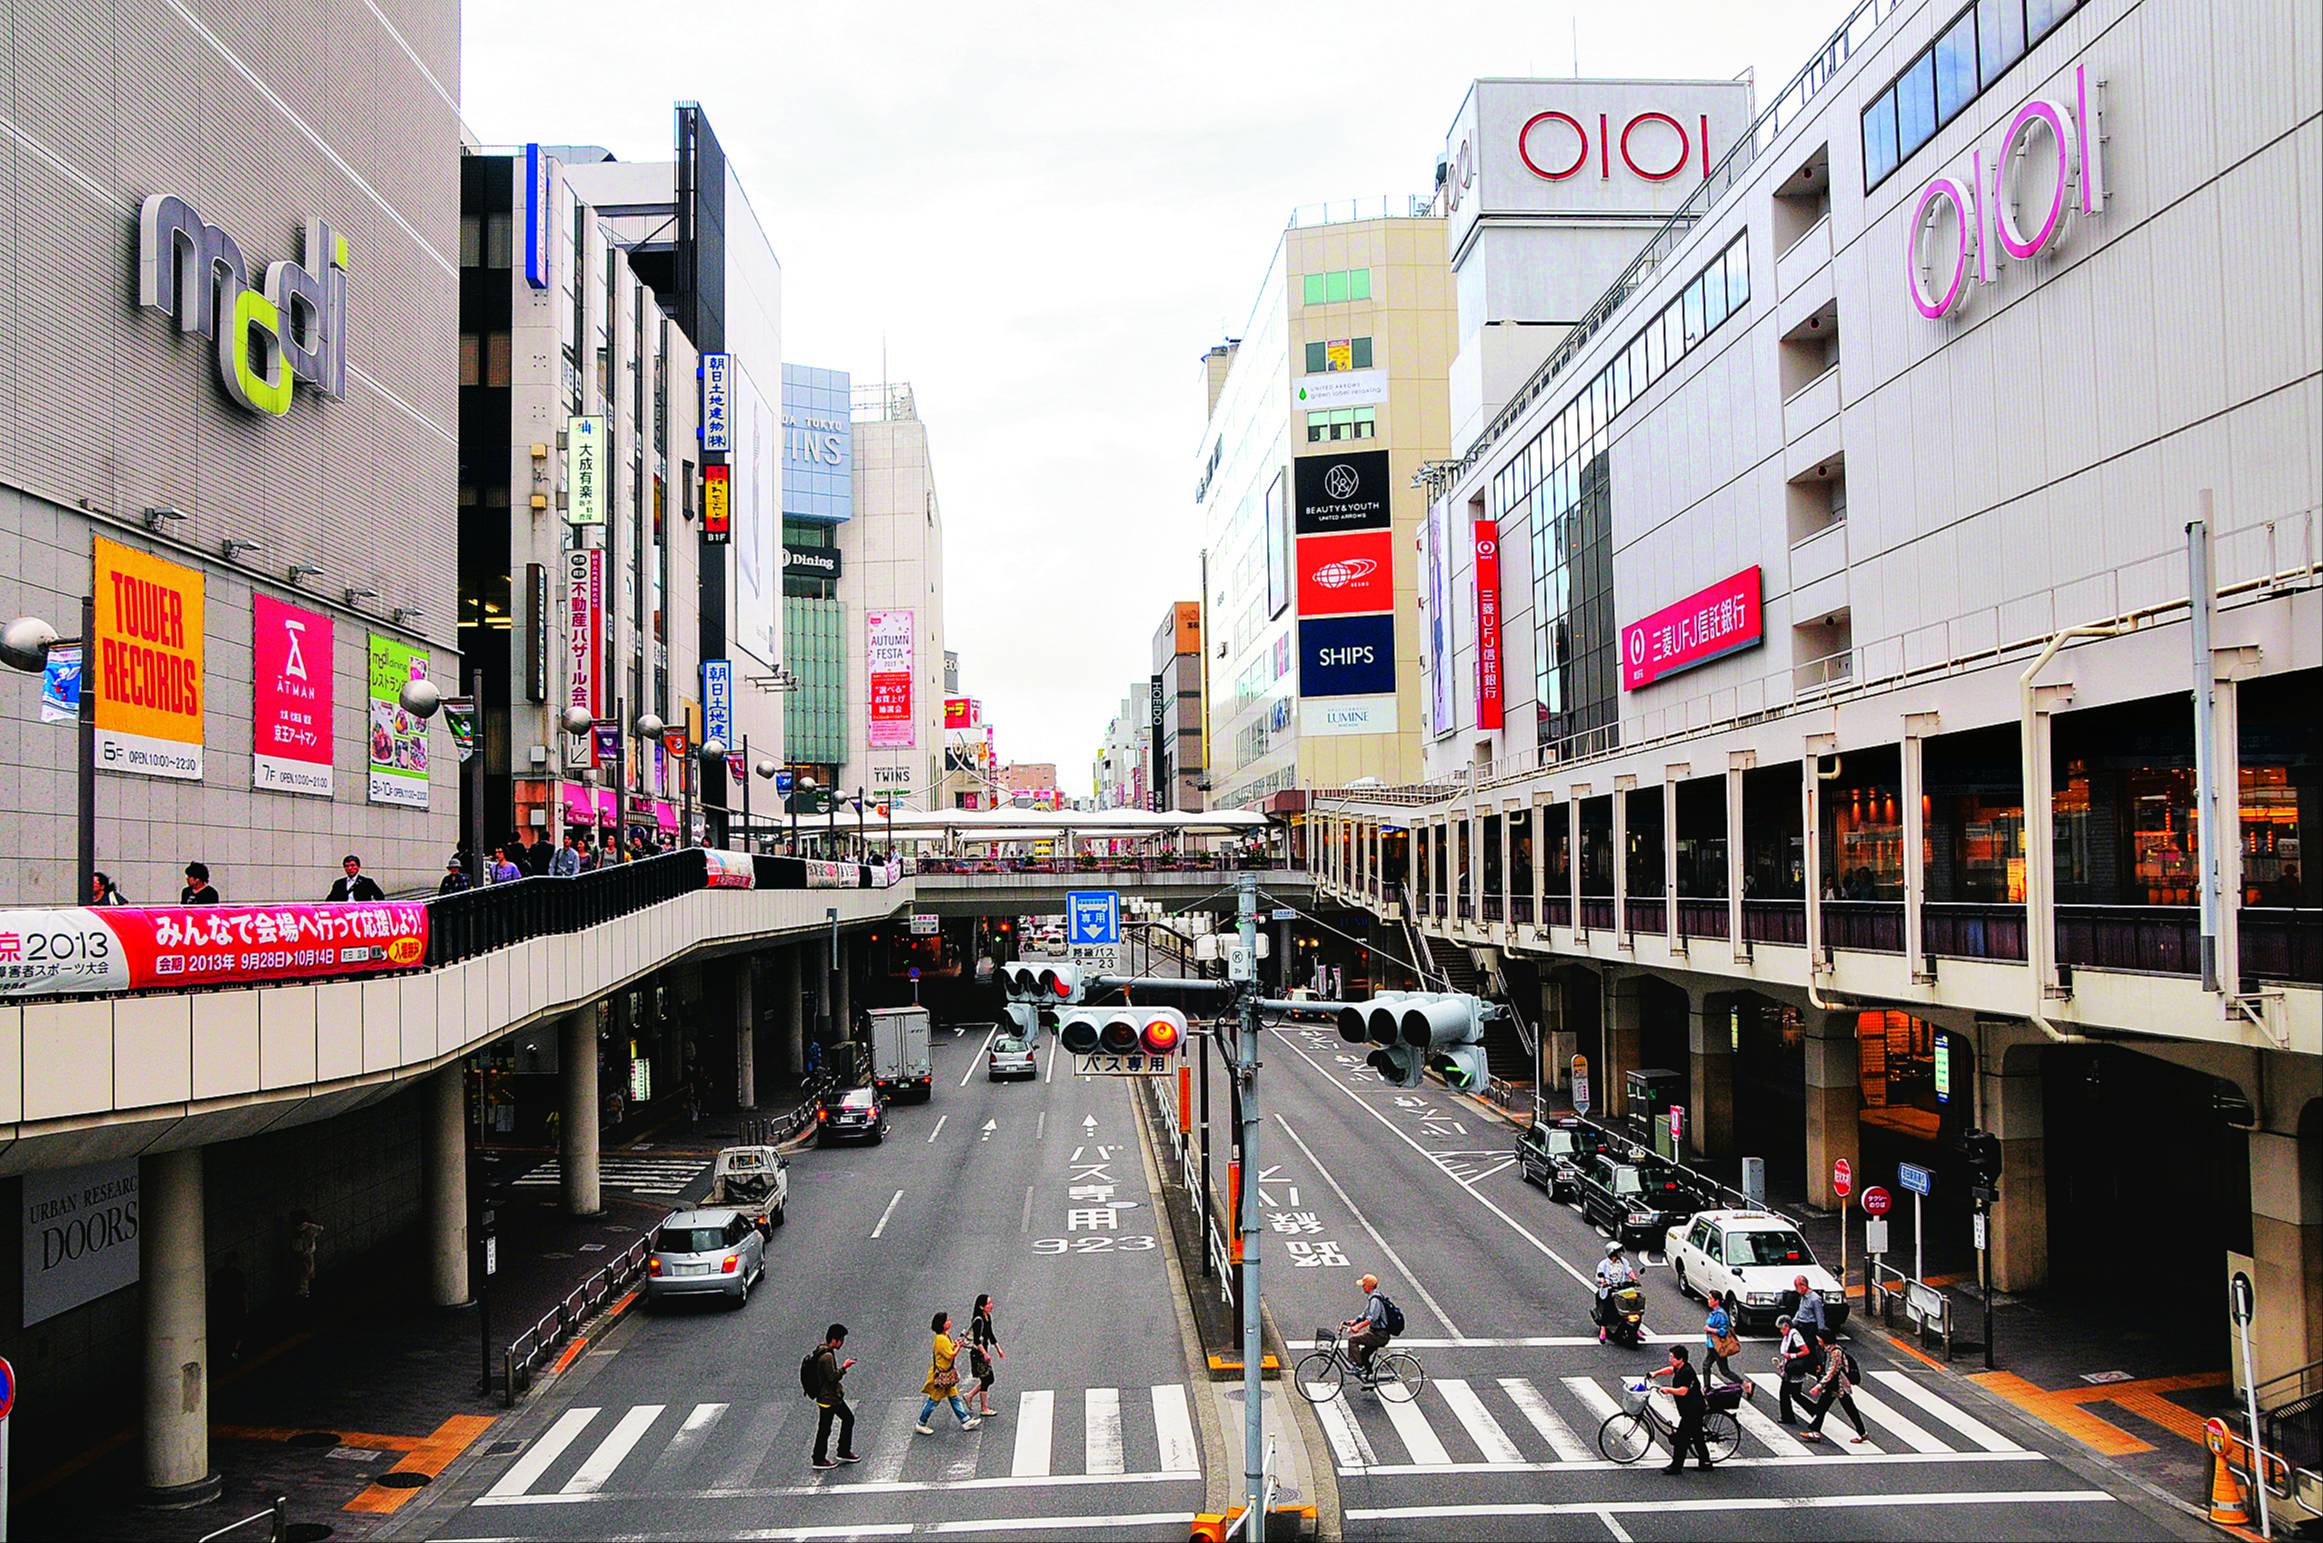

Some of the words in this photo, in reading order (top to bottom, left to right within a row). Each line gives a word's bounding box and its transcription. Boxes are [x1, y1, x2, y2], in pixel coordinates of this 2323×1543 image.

[140, 193, 348, 417] modi
[805, 416, 843, 432] TOKYU
[781, 428, 843, 466] INS
[579, 442, 593, 499] 大成有楽
[1341, 512, 1367, 520] ARROWS
[708, 533, 726, 542] B1F
[793, 553, 835, 570] Dining
[110, 570, 185, 650] TOWER
[1652, 593, 1746, 663] 三菱UFJ信託銀行
[871, 634, 909, 647] AUTUMN
[1481, 589, 1497, 699] 三菱UFJ信託銀行
[876, 648, 904, 660] FESTA
[1320, 645, 1375, 667] SHIPS
[102, 637, 198, 718] RECORDS
[708, 666, 728, 749] 朝日土地建
[1152, 681, 1163, 726] HOEIDO
[1327, 711, 1369, 724] LUMINE
[274, 724, 317, 747] 京王アートマン
[103, 741, 124, 761] 6F
[262, 764, 276, 781] 7F
[874, 771, 910, 782] TWINS
[1080, 913, 1106, 924] 専用
[1073, 947, 1116, 958] 路線バス
[157, 955, 185, 974] 会期
[189, 953, 235, 972] 2013年
[1082, 1056, 1165, 1072] バス専用
[30, 1194, 77, 1224] URBAN
[1868, 1201, 1886, 1209] のりば
[41, 1201, 138, 1272] DOORS
